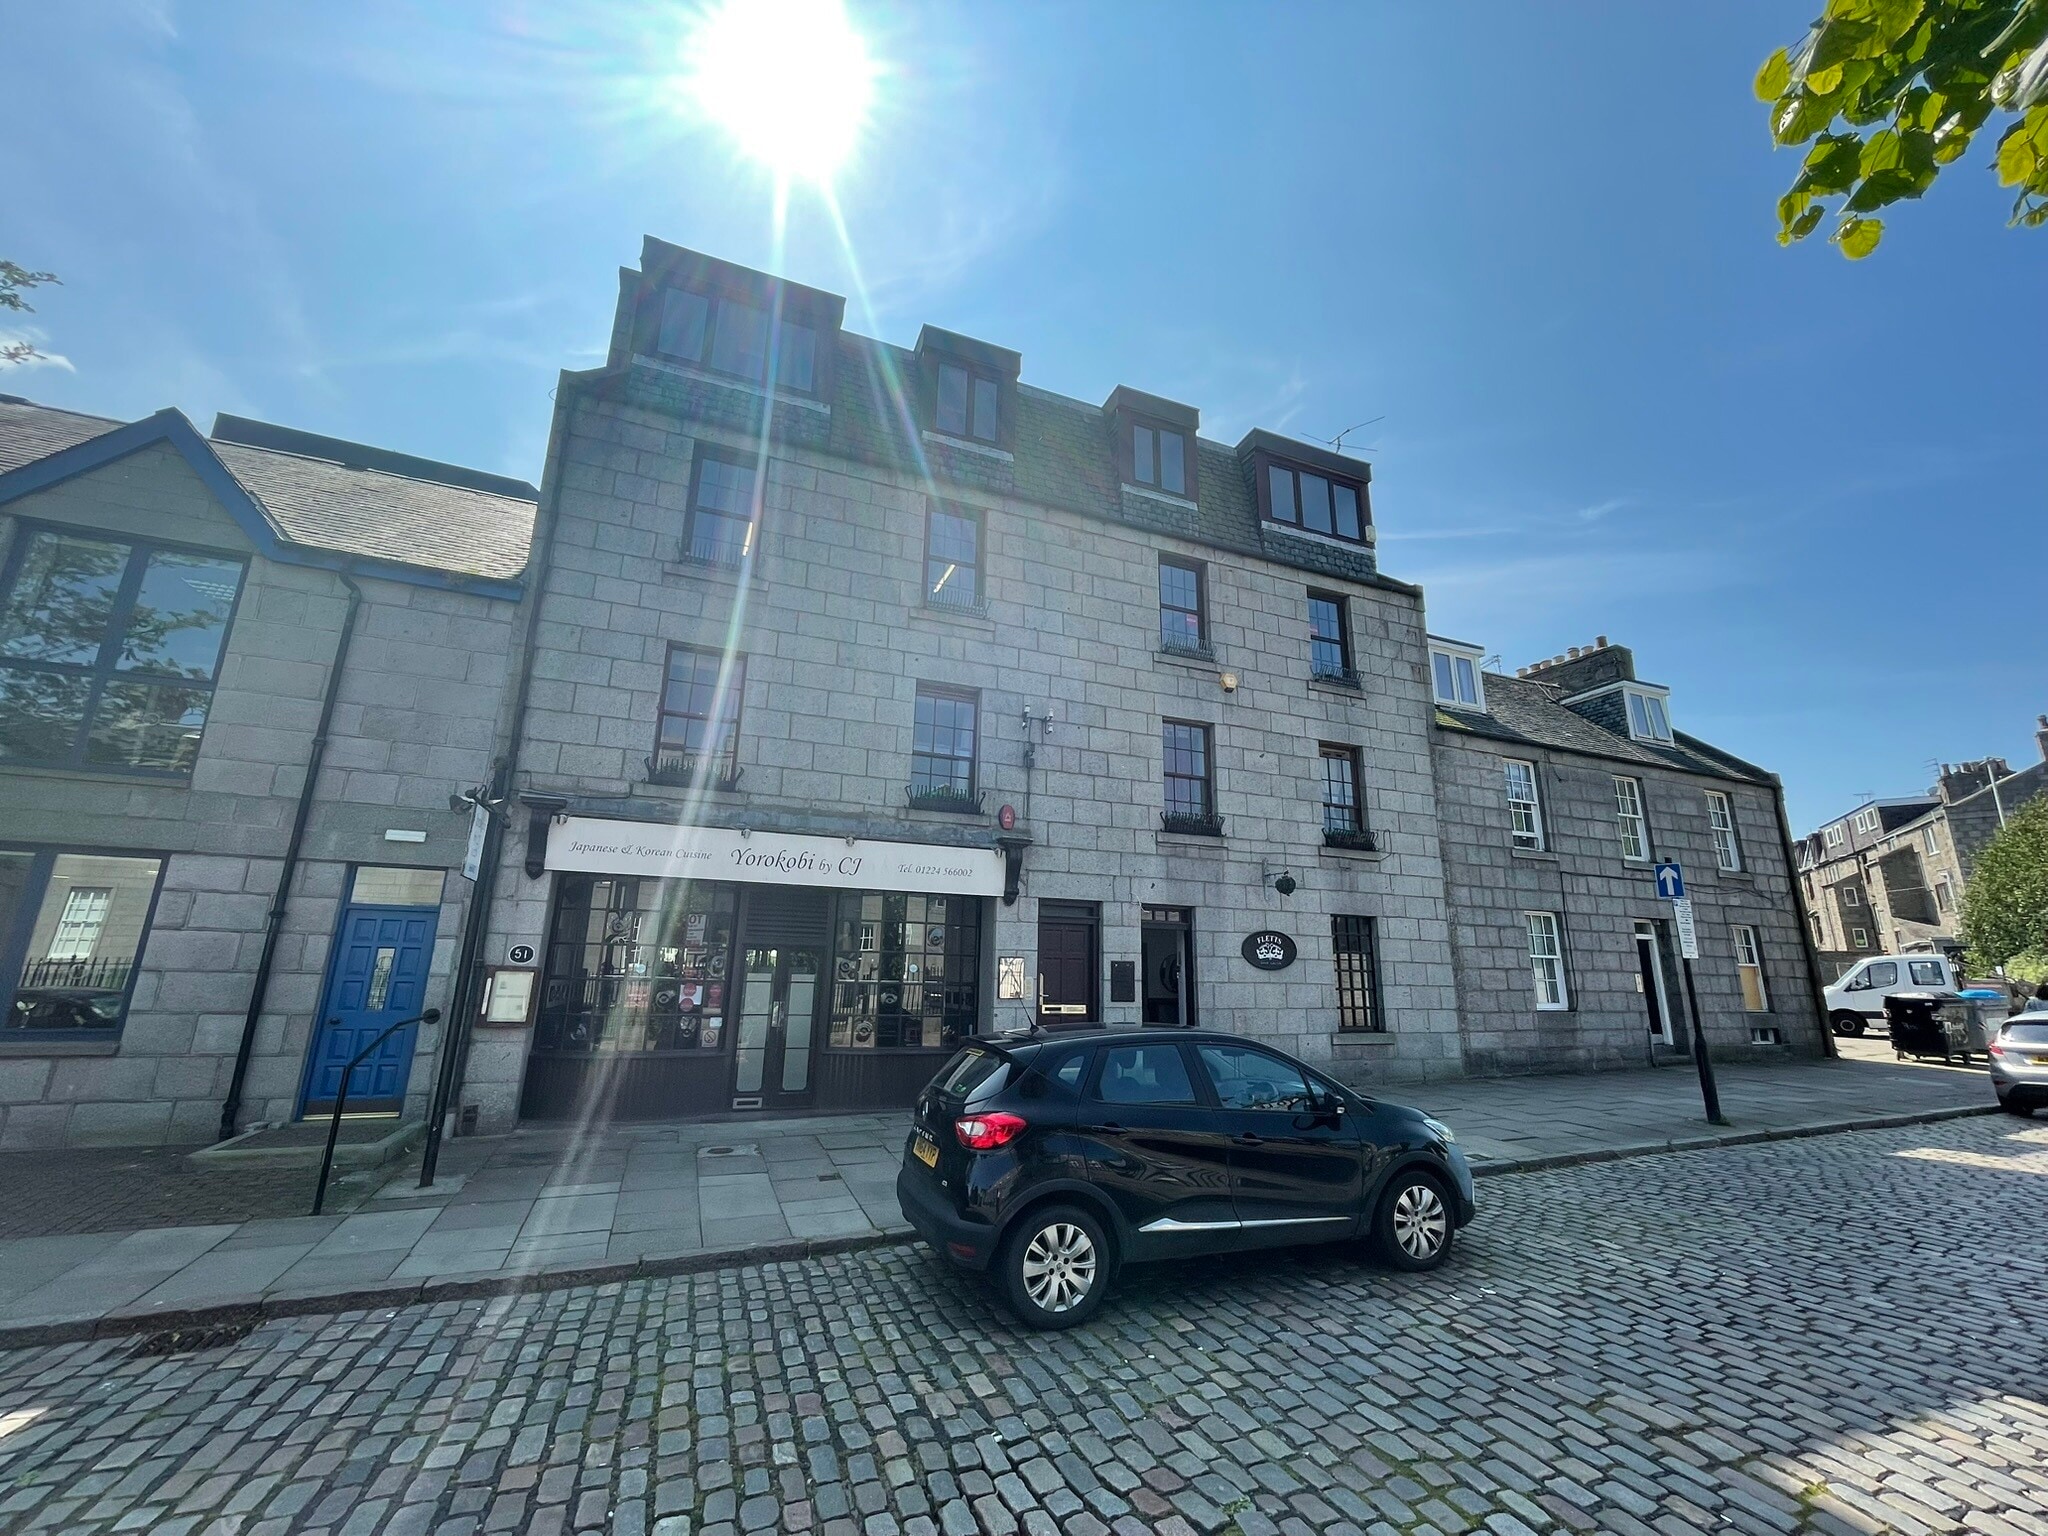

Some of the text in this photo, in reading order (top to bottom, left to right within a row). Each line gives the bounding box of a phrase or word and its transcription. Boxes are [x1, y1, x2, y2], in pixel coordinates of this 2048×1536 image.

[568, 841, 713, 860] Japanese & Korean Cuisine
[730, 847, 862, 876] Yorokobi by CJ
[915, 865, 941, 875] 01224
[943, 867, 973, 877] 566002
[1256, 934, 1282, 945] FLETTS
[514, 948, 528, 959] 51
